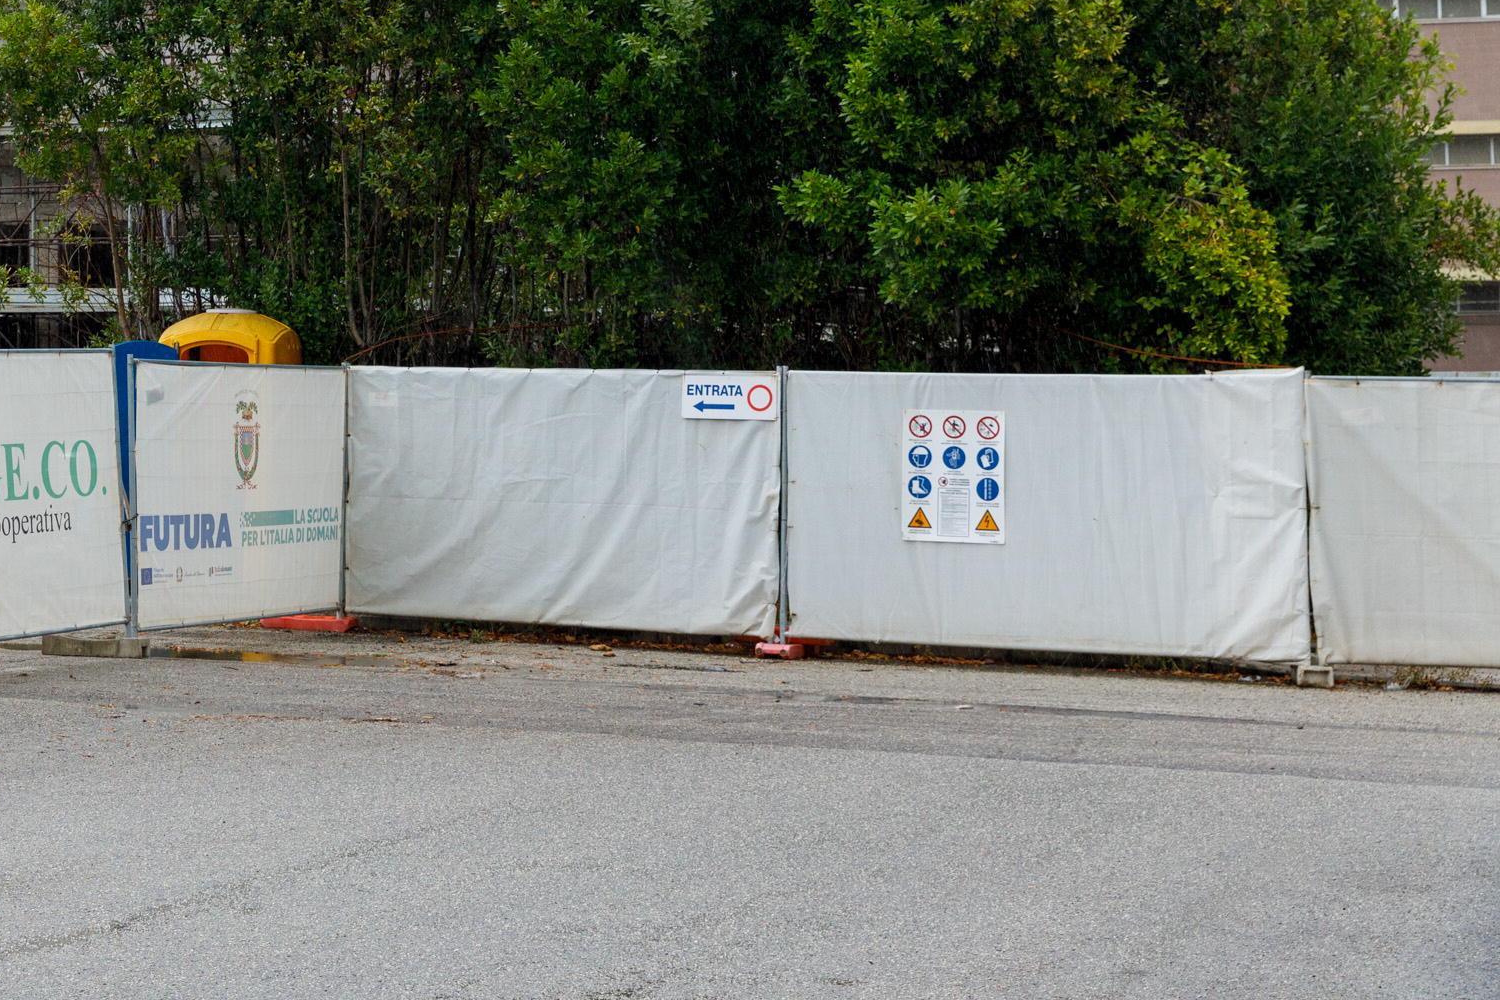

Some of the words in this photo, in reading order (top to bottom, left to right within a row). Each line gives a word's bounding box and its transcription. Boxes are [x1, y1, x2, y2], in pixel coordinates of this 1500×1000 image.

[686, 384, 743, 397] ENTRATA
[295, 508, 305, 524] LA
[307, 506, 339, 524] SCUOLA
[139, 512, 232, 552] FUTURA
[241, 530, 259, 547] PER
[260, 527, 295, 546] L'ITALIA
[296, 527, 305, 543] DI
[306, 525, 338, 542] DOMANI
